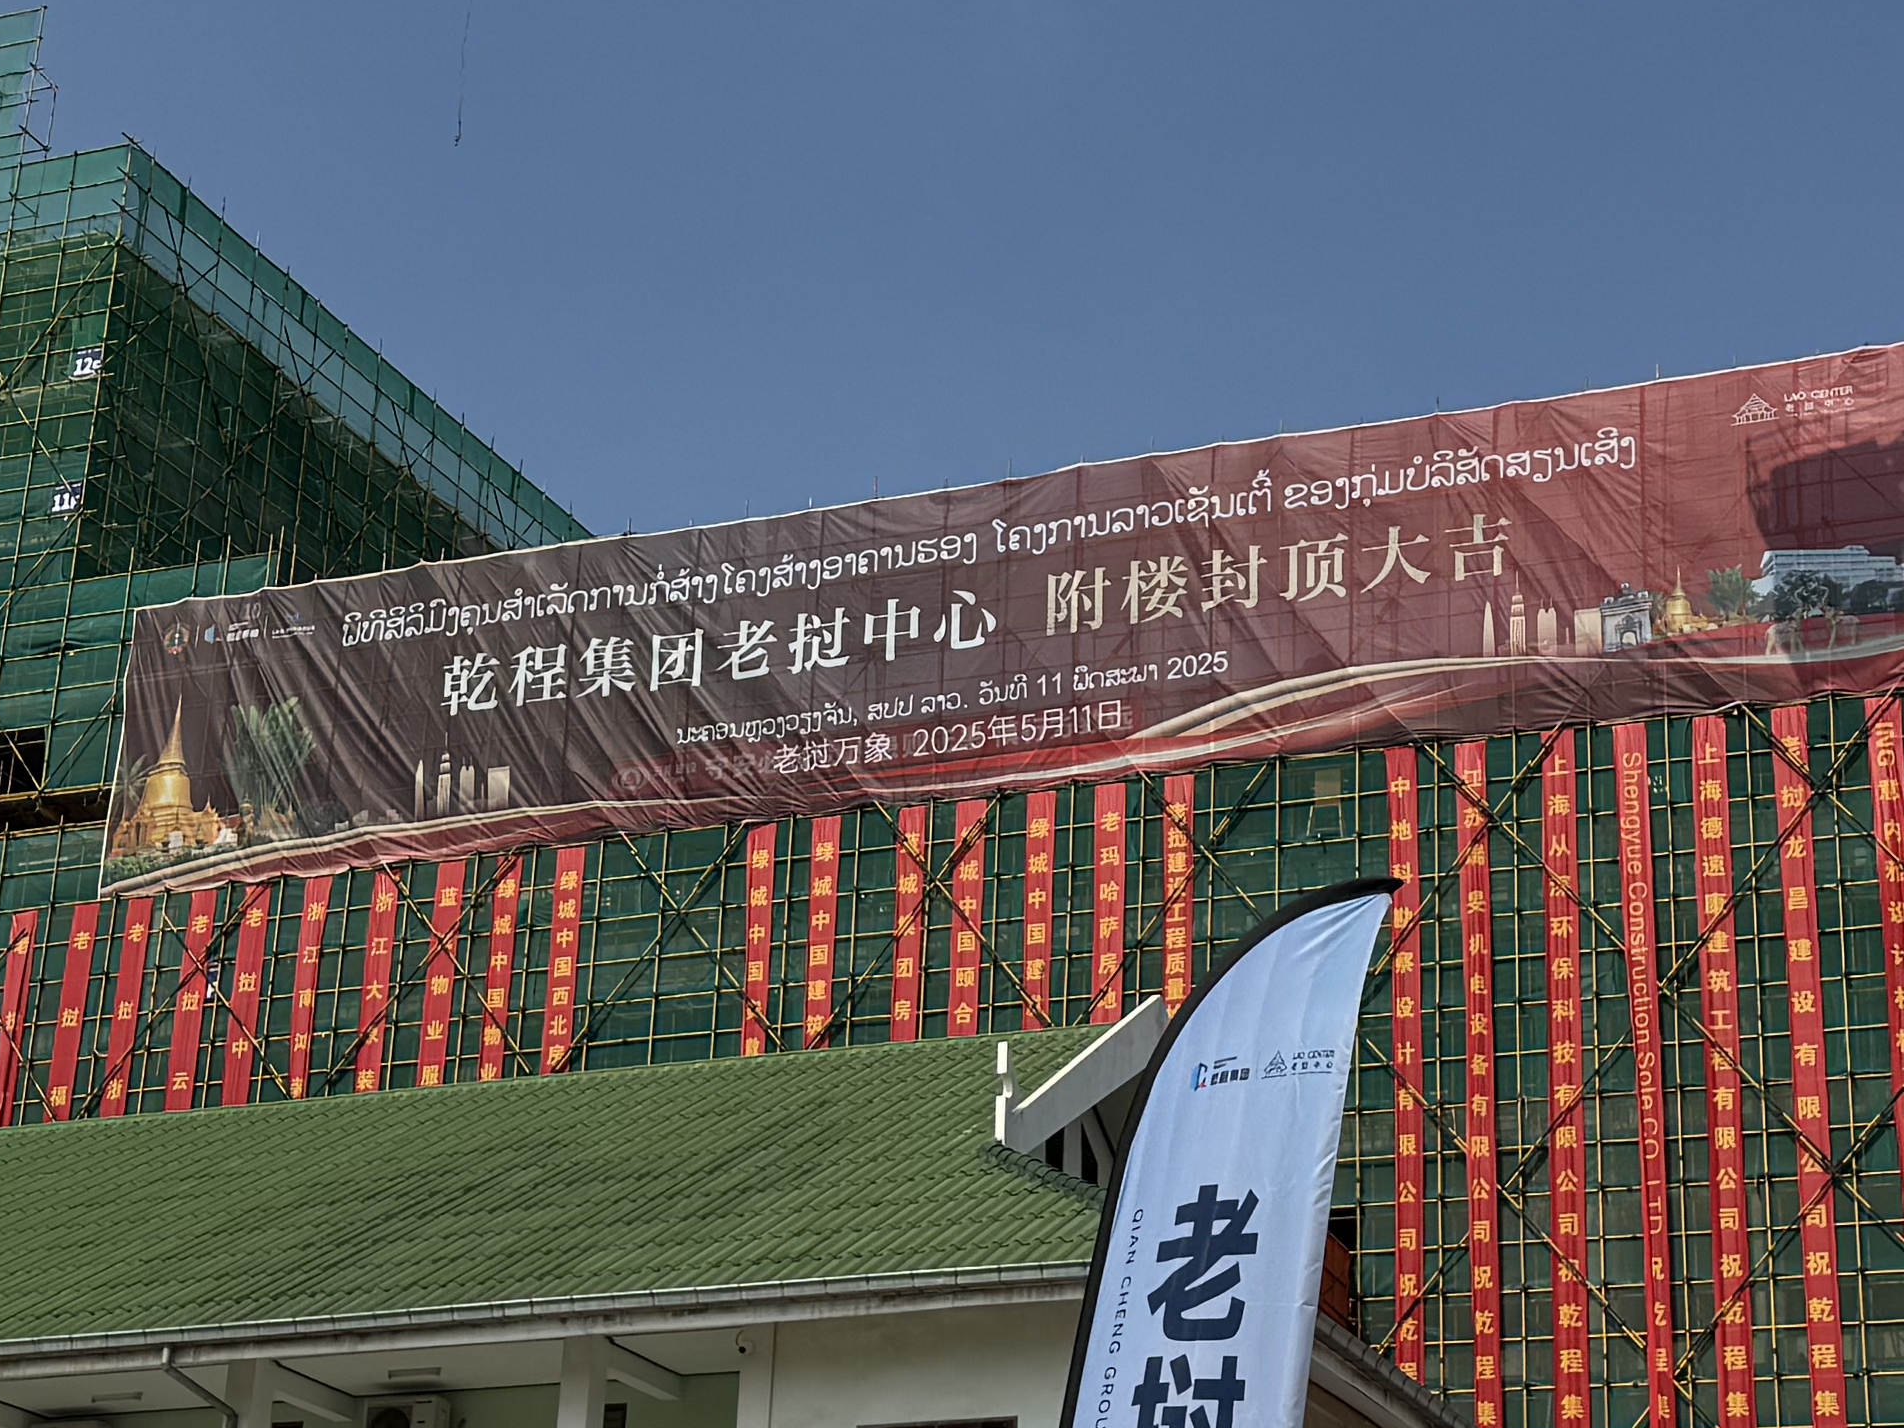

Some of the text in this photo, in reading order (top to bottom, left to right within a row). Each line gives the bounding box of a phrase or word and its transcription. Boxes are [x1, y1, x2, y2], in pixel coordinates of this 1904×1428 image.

[440, 514, 1512, 716] 乾程集团老挝中心 附楼封顶大吉
[1037, 674, 1062, 698] 11
[1167, 650, 1229, 680] 2025
[772, 699, 1124, 776] 老挝万象 2025年5月11日
[1621, 751, 1643, 875] Shengyue
[423, 886, 459, 1086] 蓝物业服
[1626, 882, 1650, 1030] Construction
[1126, 1208, 1145, 1265] QIAN
[1108, 1276, 1132, 1355] CHENG
